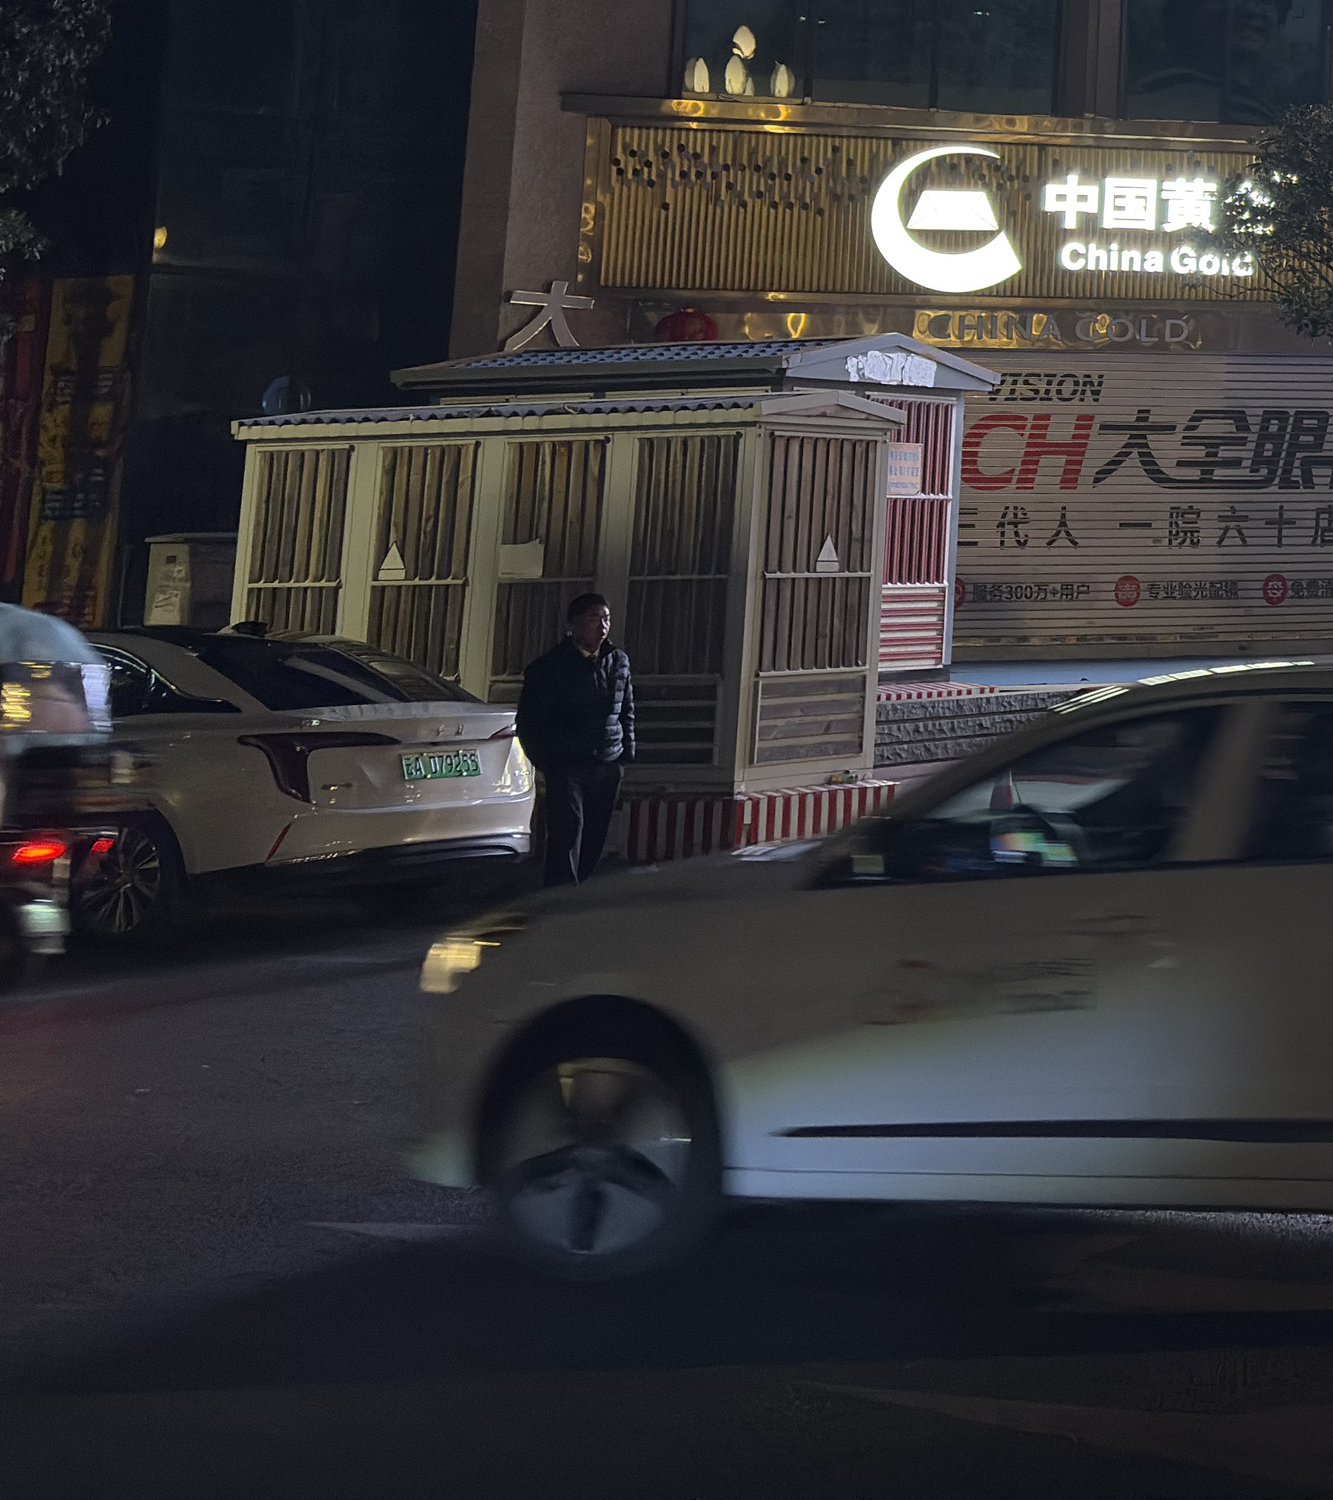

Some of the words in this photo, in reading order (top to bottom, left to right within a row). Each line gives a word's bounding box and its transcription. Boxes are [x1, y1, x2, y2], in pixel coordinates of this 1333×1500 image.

[1060, 242, 1164, 273] China
[927, 313, 1062, 343] CHINA
[1074, 316, 1192, 344] GOLD
